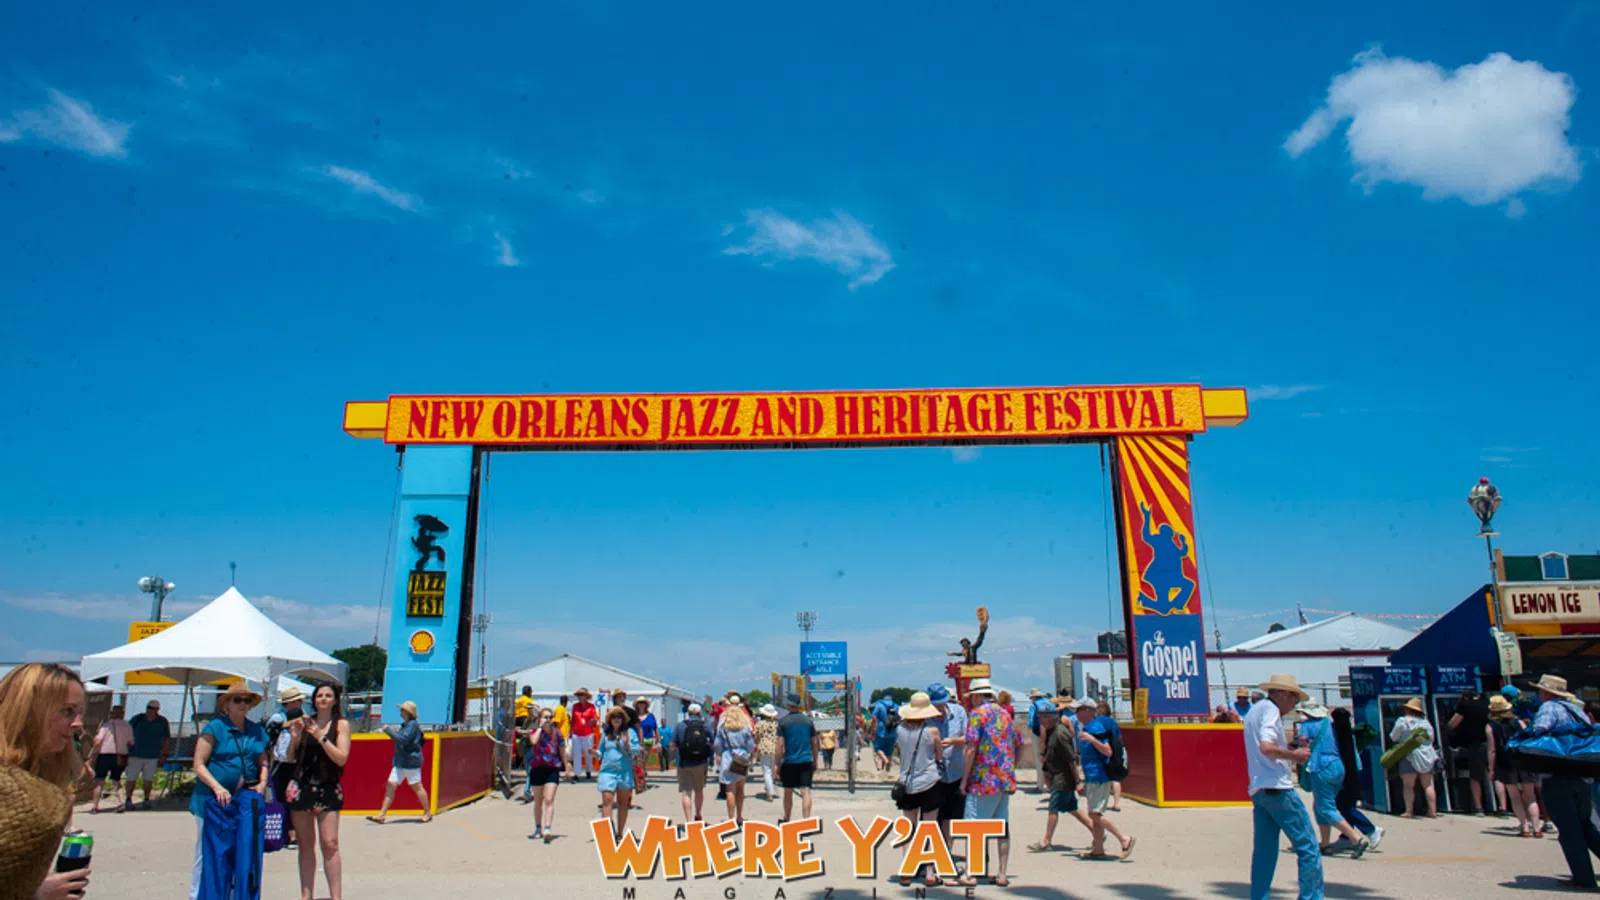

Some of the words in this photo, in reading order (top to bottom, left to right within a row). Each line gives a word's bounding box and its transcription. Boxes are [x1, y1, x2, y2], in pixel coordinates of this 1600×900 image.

[406, 399, 485, 438] NEW
[492, 397, 650, 439] ORLEANS
[658, 396, 742, 442] JAZZ
[750, 395, 824, 437] AND
[834, 391, 1014, 436] HERITAGE
[1023, 388, 1184, 432] FESTIVAL
[410, 573, 445, 592] JAZZ
[408, 595, 444, 614] FEST
[1511, 592, 1557, 615] LEMON
[1560, 592, 1582, 614] ICE
[1142, 640, 1199, 681] Gospel
[1385, 673, 1413, 685] ATM
[1439, 672, 1467, 684] ATM
[1163, 678, 1191, 699] Tent
